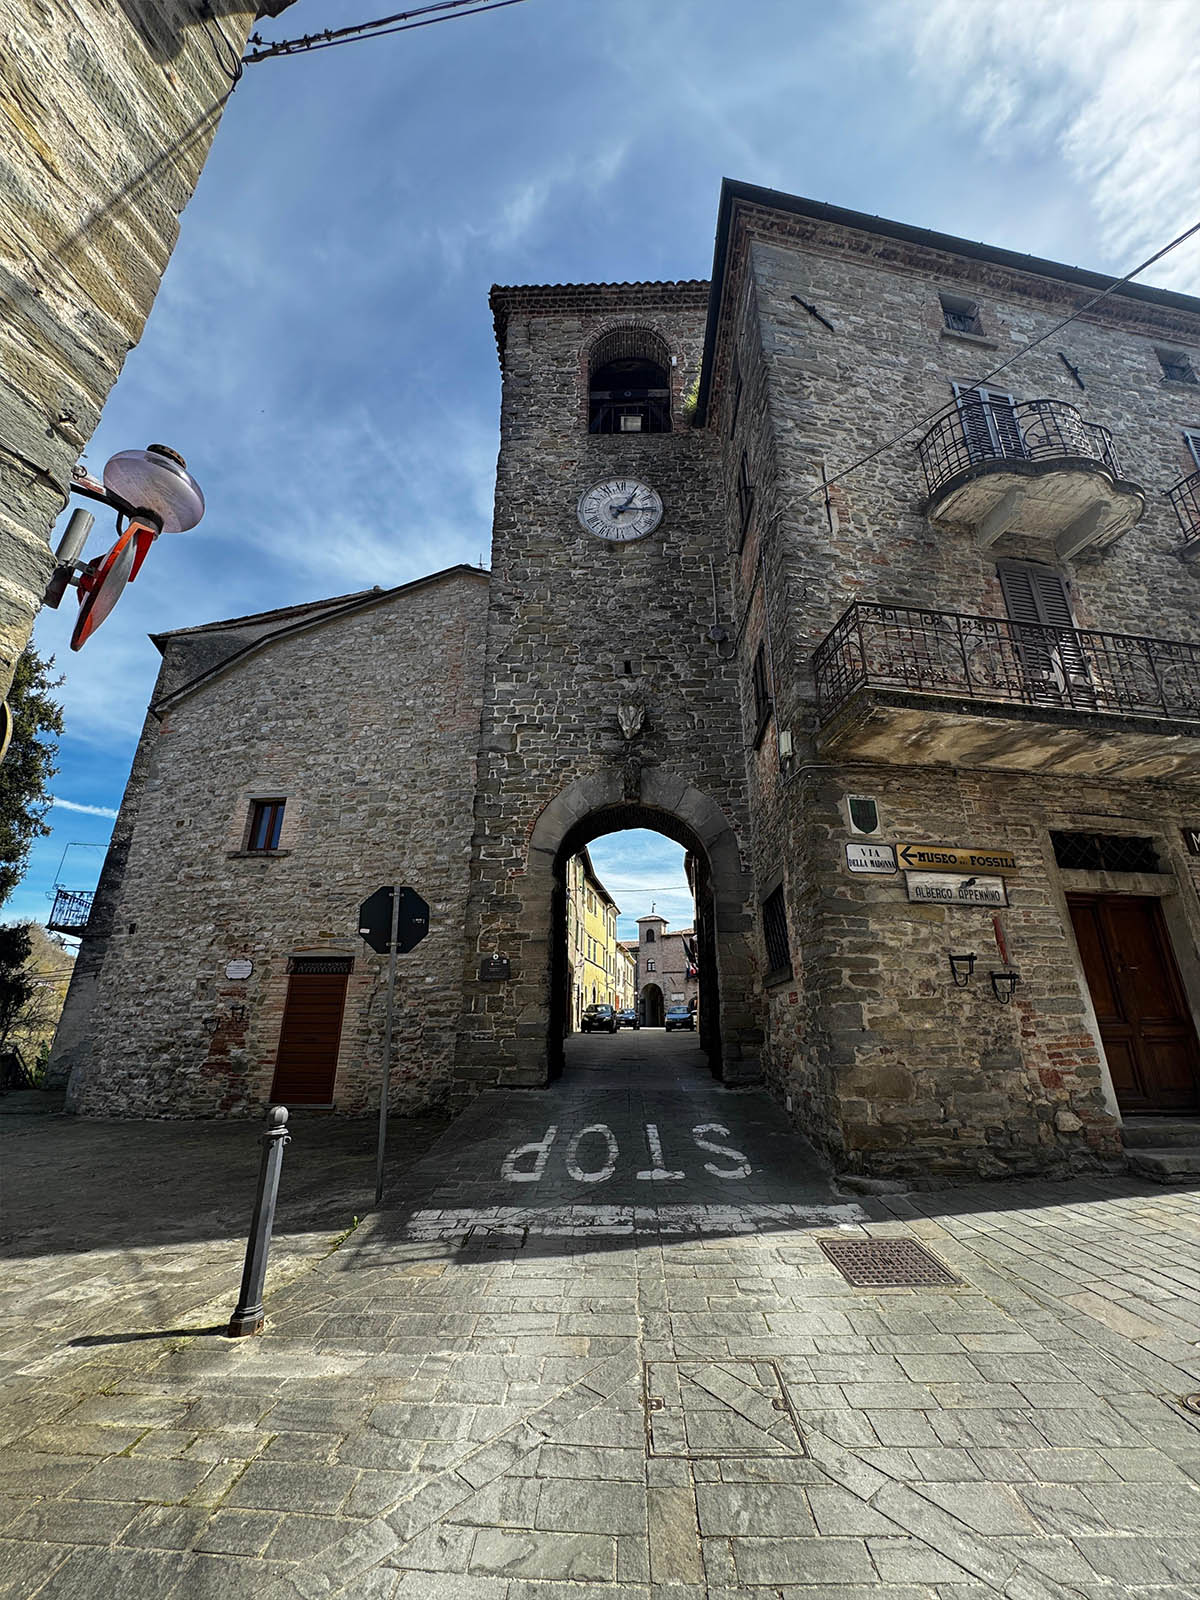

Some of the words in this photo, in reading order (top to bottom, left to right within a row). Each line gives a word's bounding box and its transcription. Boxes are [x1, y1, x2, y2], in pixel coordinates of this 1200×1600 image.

[861, 848, 880, 857] VIA
[917, 851, 957, 865] MUSEO
[970, 855, 1017, 868] FOSSILI
[848, 858, 868, 868] DELLA
[915, 886, 953, 900] ALBERGO
[958, 887, 1001, 902] APPENNINO
[502, 1122, 753, 1183] STOP
